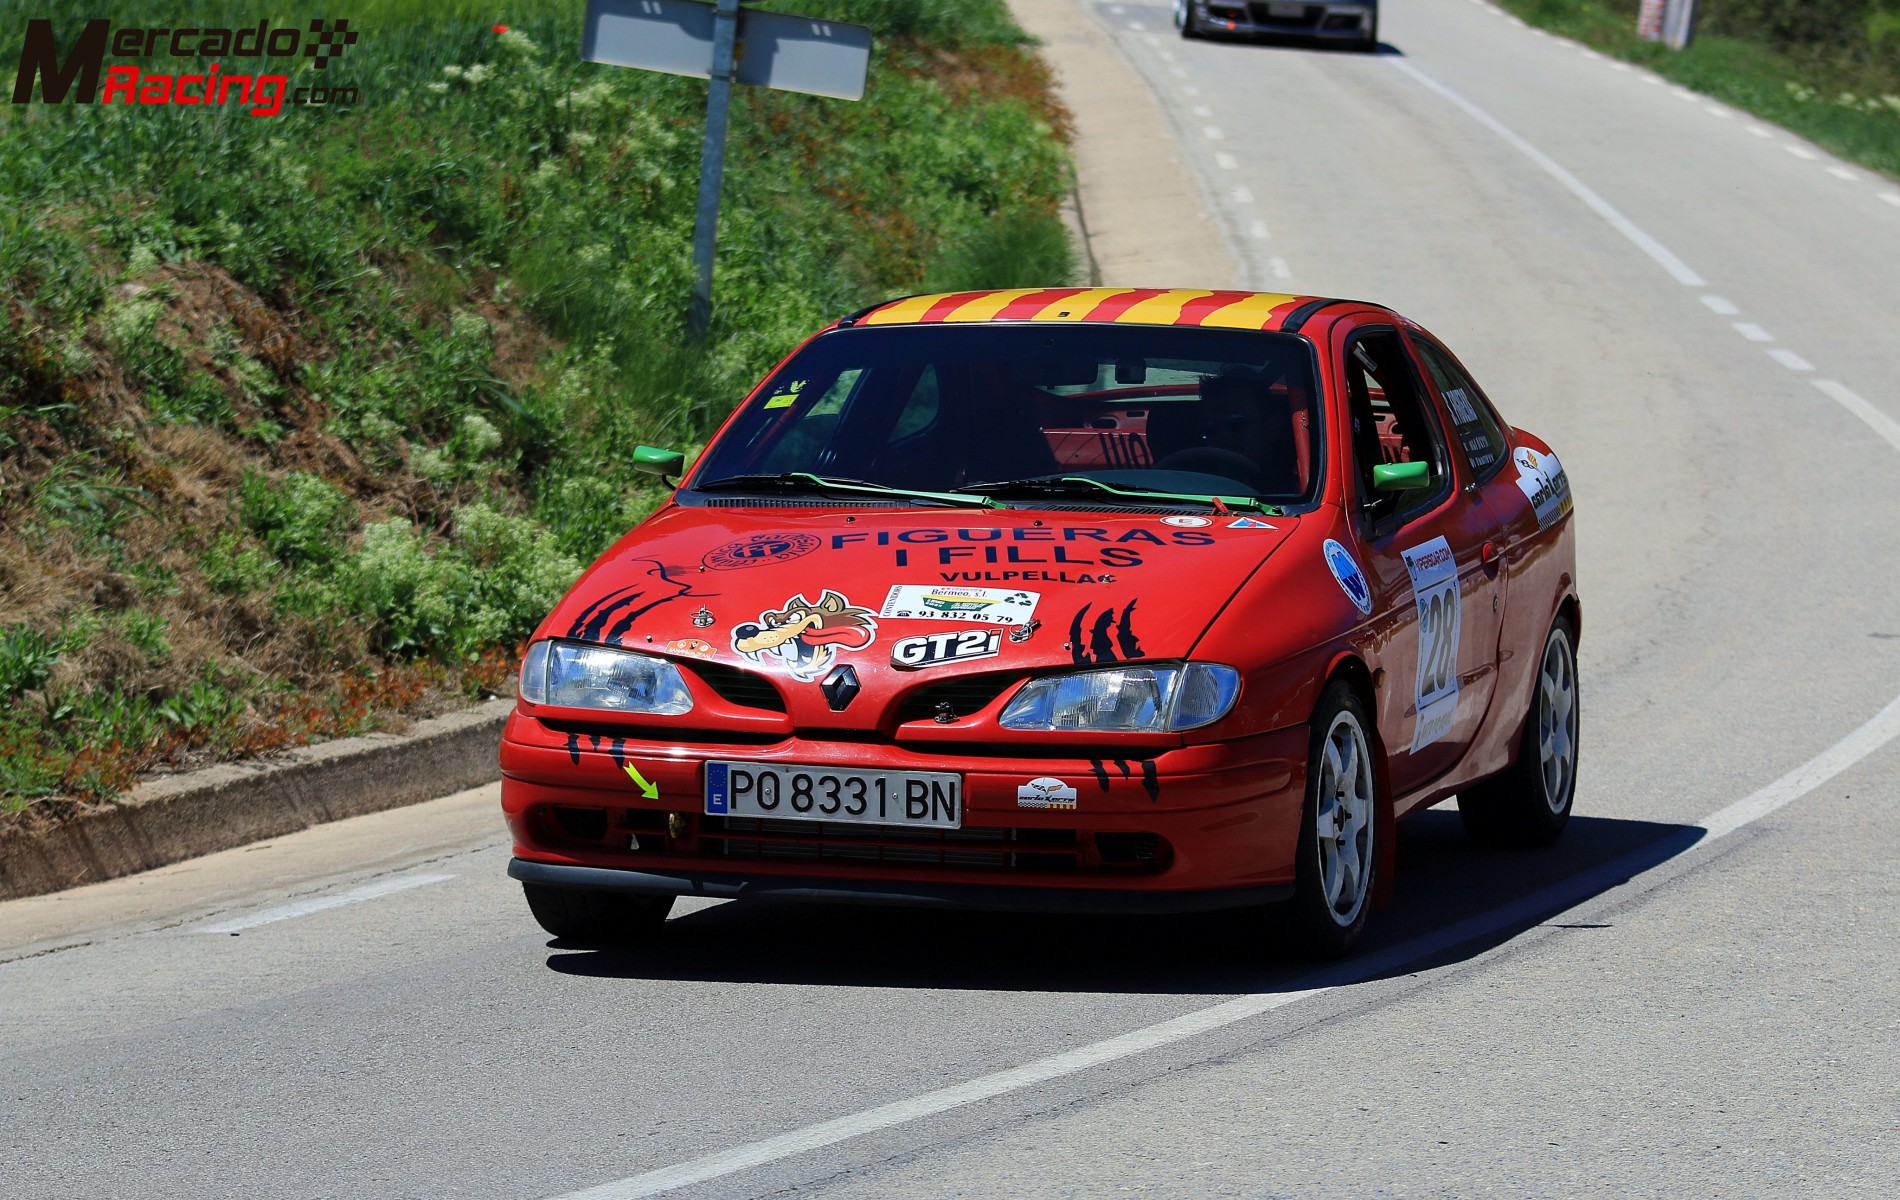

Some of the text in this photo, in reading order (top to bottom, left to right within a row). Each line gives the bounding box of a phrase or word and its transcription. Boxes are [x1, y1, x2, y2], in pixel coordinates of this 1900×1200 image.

[832, 528, 1215, 549] FIGUERAS
[896, 546, 1143, 567] I FILLS
[940, 571, 1117, 584] VULPELLAC
[931, 588, 971, 598] Bermeo,
[941, 611, 967, 619] 832
[972, 613, 990, 621] 05
[996, 615, 1013, 623] 79
[1422, 588, 1455, 697] 28
[713, 793, 722, 805] E
[790, 773, 887, 817] 8331
[905, 779, 956, 822] BN
